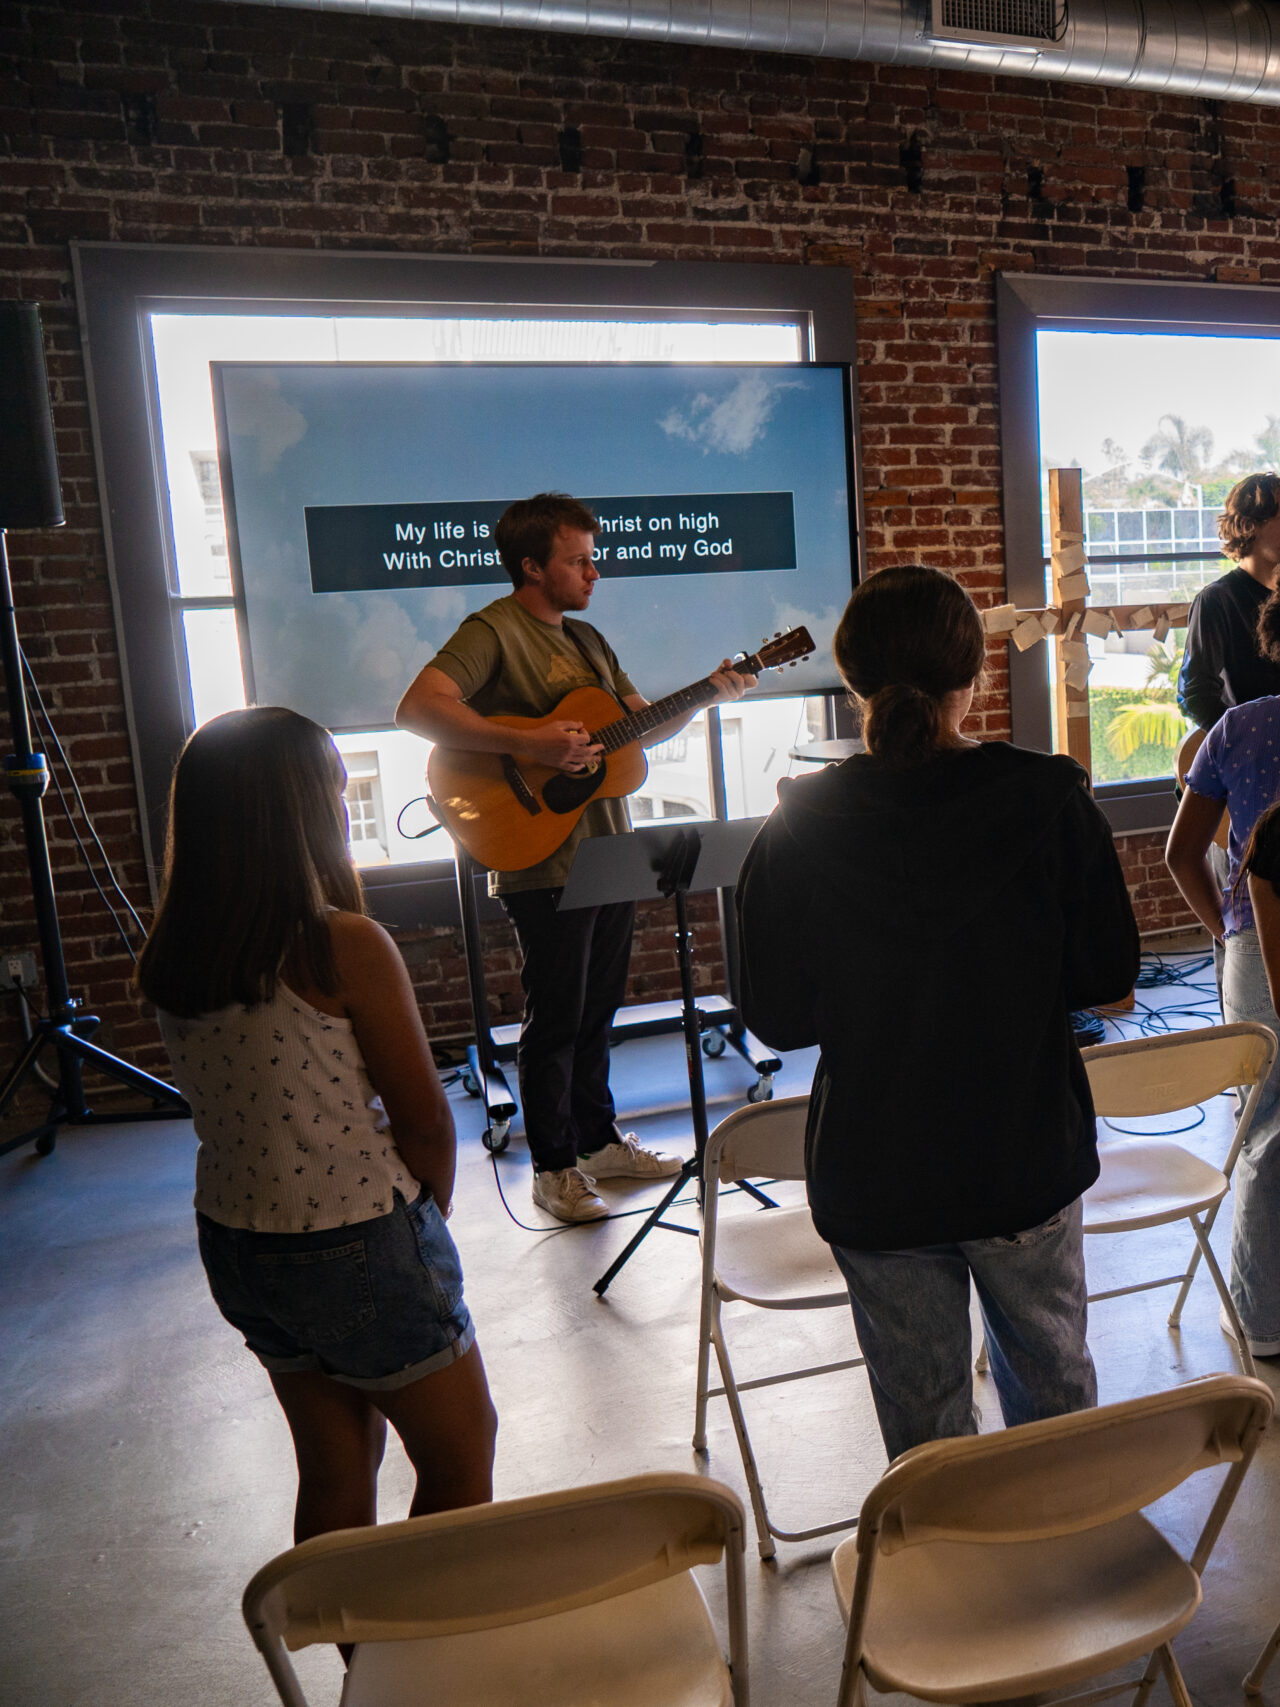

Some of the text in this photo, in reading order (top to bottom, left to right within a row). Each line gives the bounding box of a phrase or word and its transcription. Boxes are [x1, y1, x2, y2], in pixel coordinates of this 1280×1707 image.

[395, 520, 490, 545] My life is
[594, 512, 719, 534] hrist on high
[382, 548, 501, 571] With Christ
[616, 541, 652, 560] and
[659, 543, 687, 561] my
[693, 538, 733, 557] God
